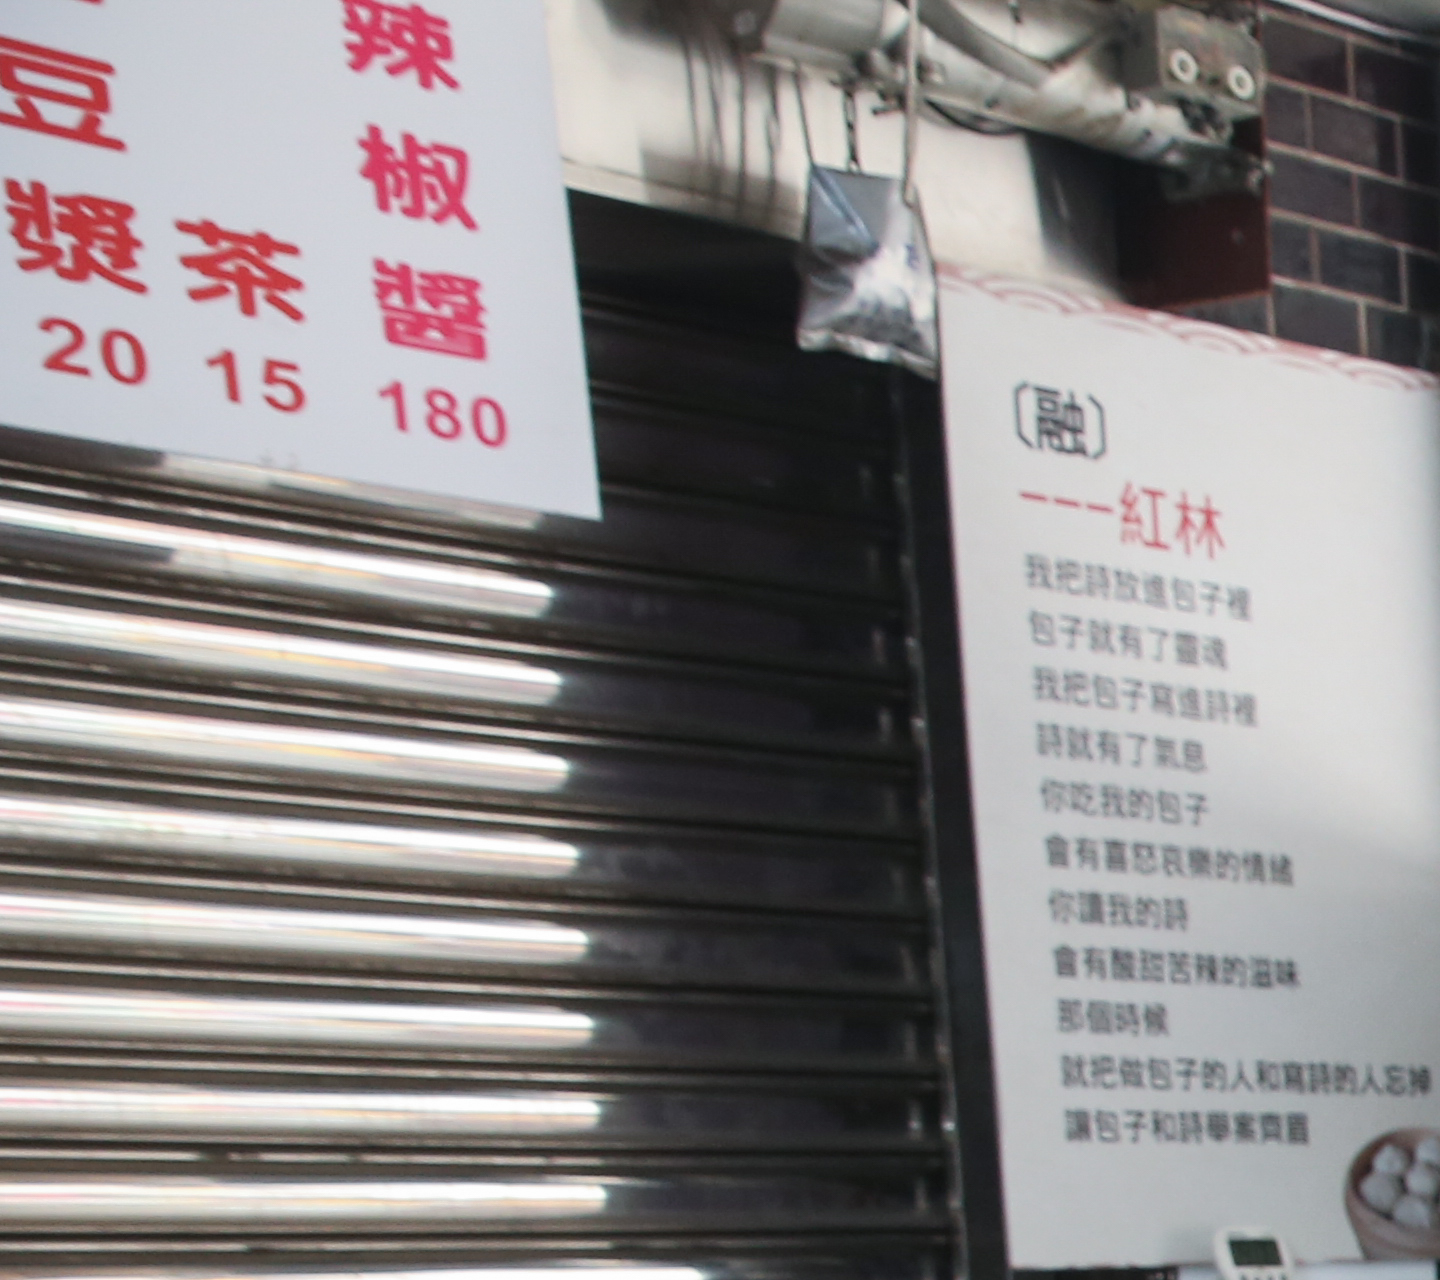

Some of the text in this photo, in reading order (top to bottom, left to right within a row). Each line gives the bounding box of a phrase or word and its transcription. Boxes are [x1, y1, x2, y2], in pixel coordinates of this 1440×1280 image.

[0, 0, 149, 296] 豆漿
[341, 0, 489, 361] 辣椒醬
[173, 219, 306, 322] 茶
[39, 316, 149, 387] 20
[207, 350, 307, 414] 15
[379, 380, 510, 450] 180
[1040, 780, 1210, 827] 你吃我的包子
